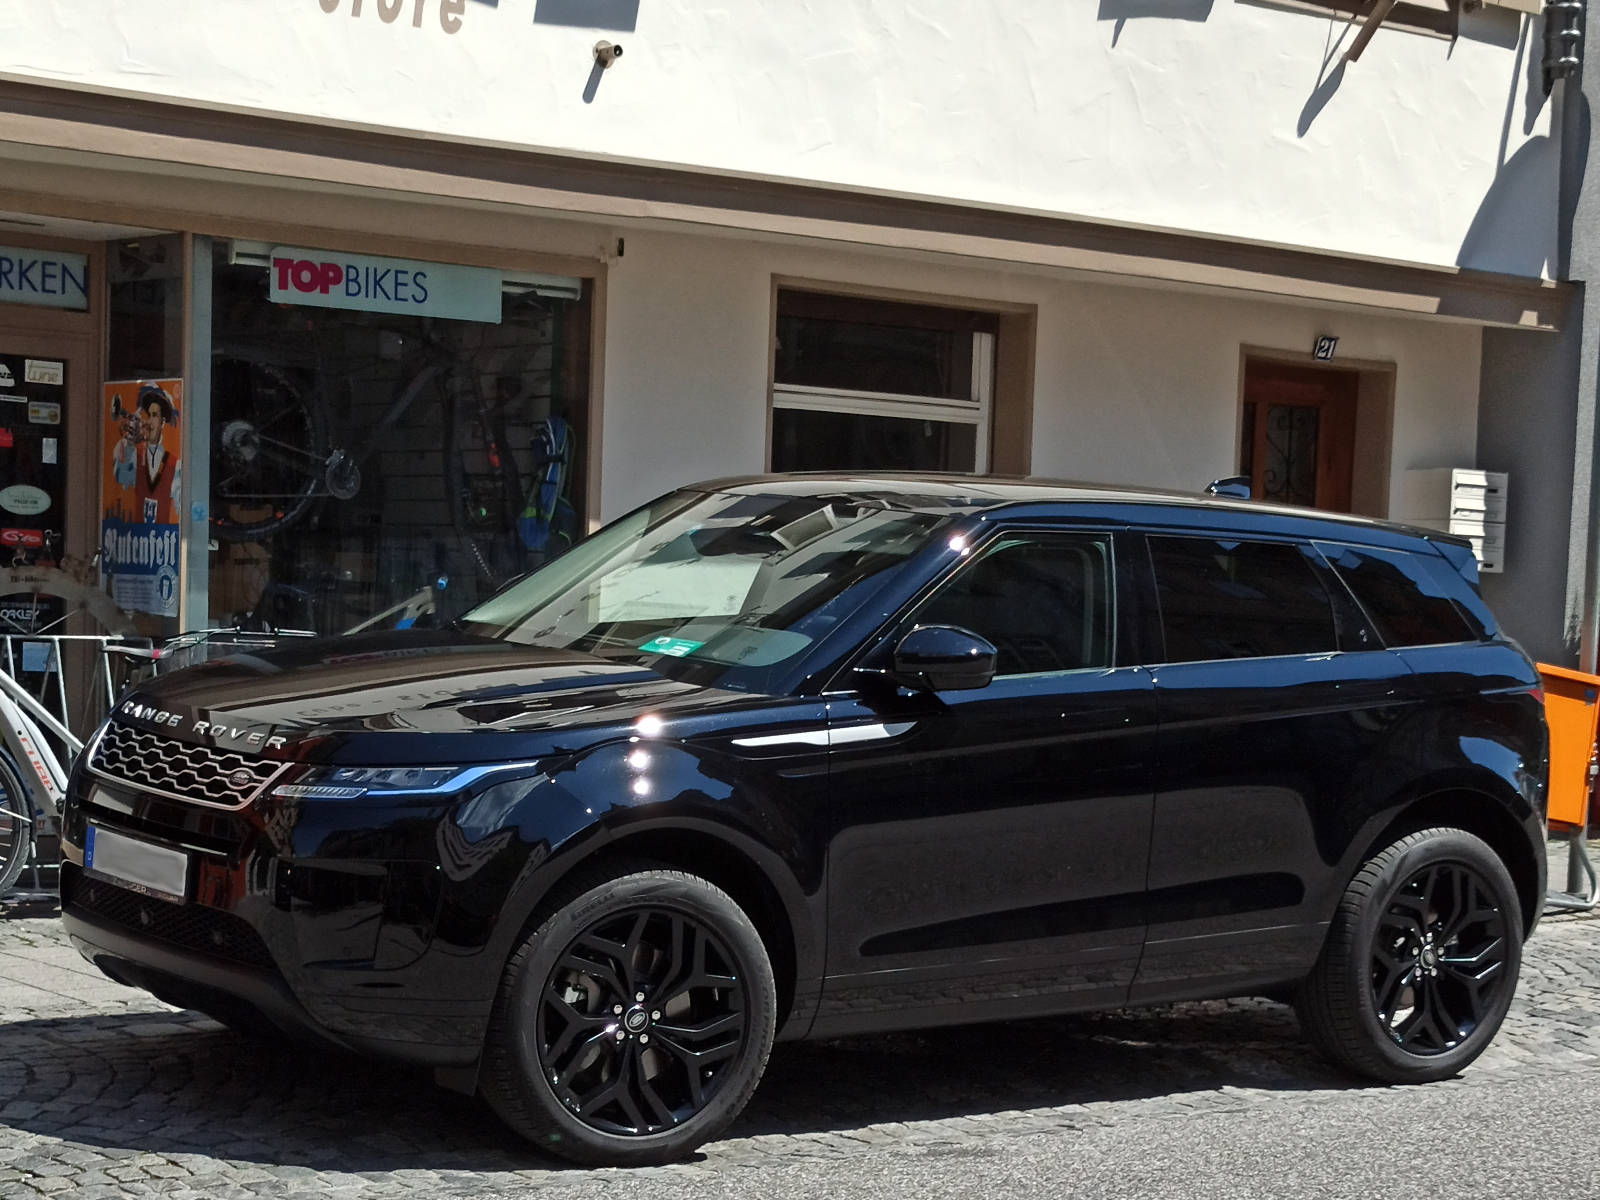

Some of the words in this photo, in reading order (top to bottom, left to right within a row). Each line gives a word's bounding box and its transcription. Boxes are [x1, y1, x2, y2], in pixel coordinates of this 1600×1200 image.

[1317, 339, 1336, 358] 21
[0, 608, 40, 620] OAKLEY
[121, 700, 183, 727] RANGE
[192, 720, 287, 750] ROVER
